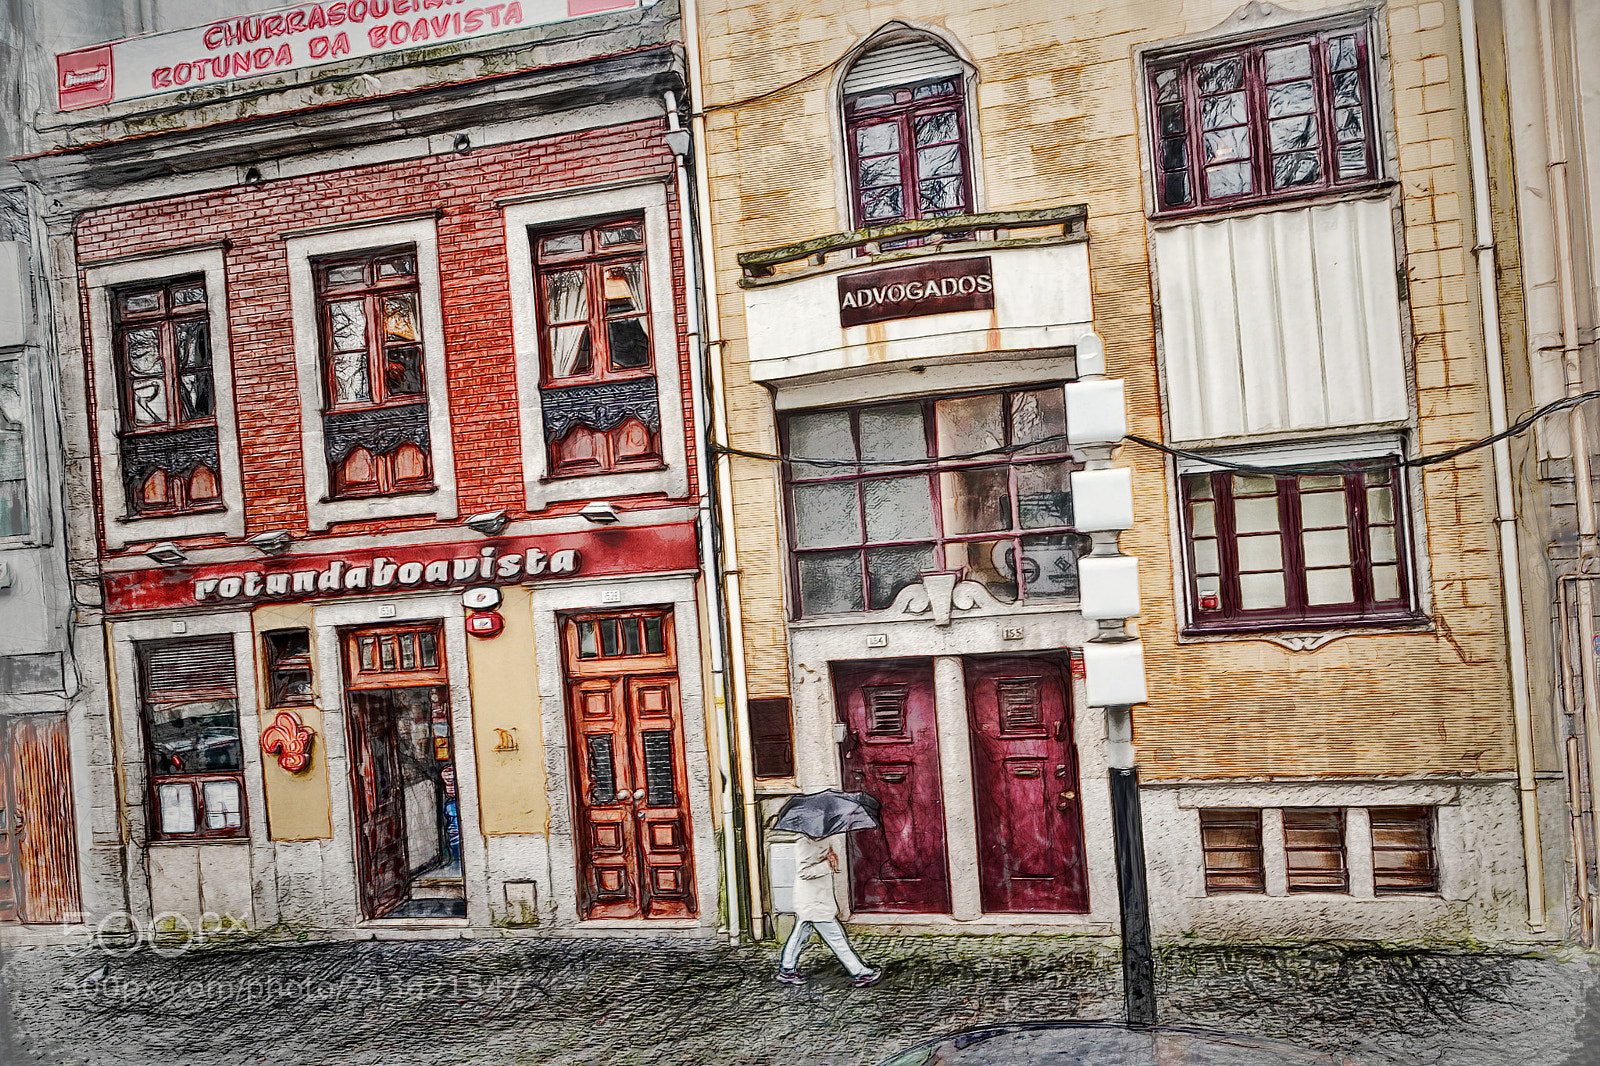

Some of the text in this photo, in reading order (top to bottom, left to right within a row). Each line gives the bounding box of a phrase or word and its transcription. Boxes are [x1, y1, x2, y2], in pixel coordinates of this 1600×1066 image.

[152, 43, 293, 90] ROTUNDA
[308, 31, 351, 60] DA
[367, 1, 523, 49] BOAVISTA
[203, 0, 465, 50] CHURRASQUEI
[841, 273, 993, 310] ADVOGADOS
[194, 546, 580, 601] rotundaboavista
